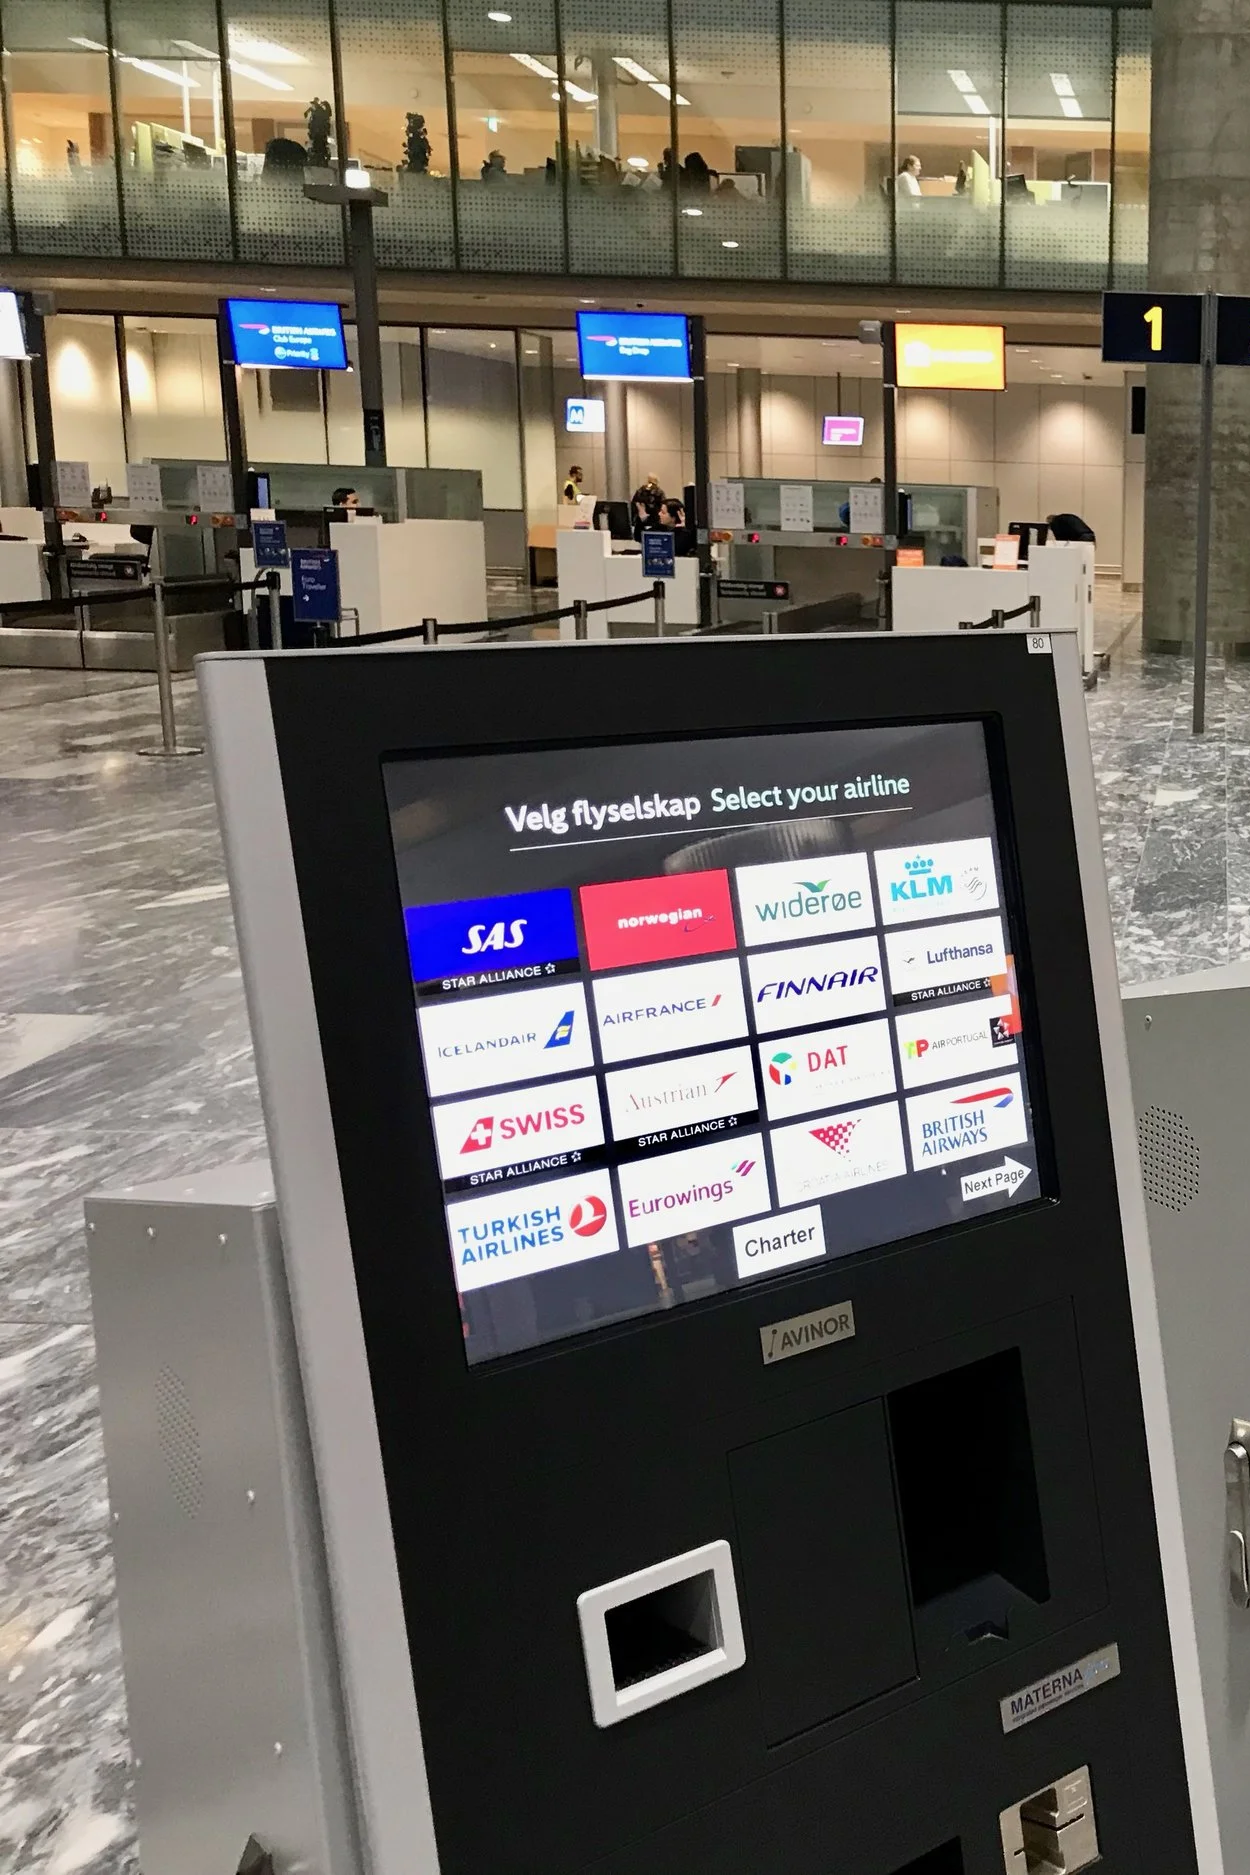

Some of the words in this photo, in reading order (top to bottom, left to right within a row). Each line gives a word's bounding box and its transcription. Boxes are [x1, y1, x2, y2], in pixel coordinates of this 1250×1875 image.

[1143, 306, 1163, 351] 1
[1032, 637, 1044, 649] 80
[505, 804, 569, 834] Velg
[572, 793, 701, 830] flyselskap
[711, 786, 783, 812] Select
[786, 784, 838, 810] your
[844, 774, 910, 799] airline
[890, 875, 952, 901] KLM
[618, 907, 702, 929] norwegian
[755, 890, 862, 921] widerøe
[461, 919, 528, 955] SAS
[927, 943, 993, 964] Lufthansa
[442, 976, 476, 990] STAR
[479, 966, 541, 985] ALLIANCE
[757, 966, 879, 1003] FINNAIR
[911, 989, 935, 1001] STAR
[936, 980, 982, 998] ALLIANCE
[438, 1032, 537, 1058] ICELANDAIR
[807, 1045, 848, 1072] DAT
[626, 1082, 708, 1113] Austrian
[499, 1103, 585, 1139] SWISS
[638, 1132, 668, 1147] STAR
[670, 1119, 725, 1140] ALLIANCE
[922, 1109, 986, 1139] BRITISH
[922, 1127, 988, 1157] AIRWAYS
[470, 1170, 503, 1186] STAR
[506, 1155, 568, 1178] ALLIANCE
[964, 1177, 993, 1195] Next
[995, 1168, 1025, 1186] Page
[628, 1179, 734, 1218] Eurowings
[458, 1206, 561, 1243] TURKISH
[461, 1225, 564, 1265] AIRLINES
[745, 1225, 816, 1258] Charter
[780, 1314, 850, 1350] AVINOR
[1010, 1668, 1083, 1714] MATERNA
